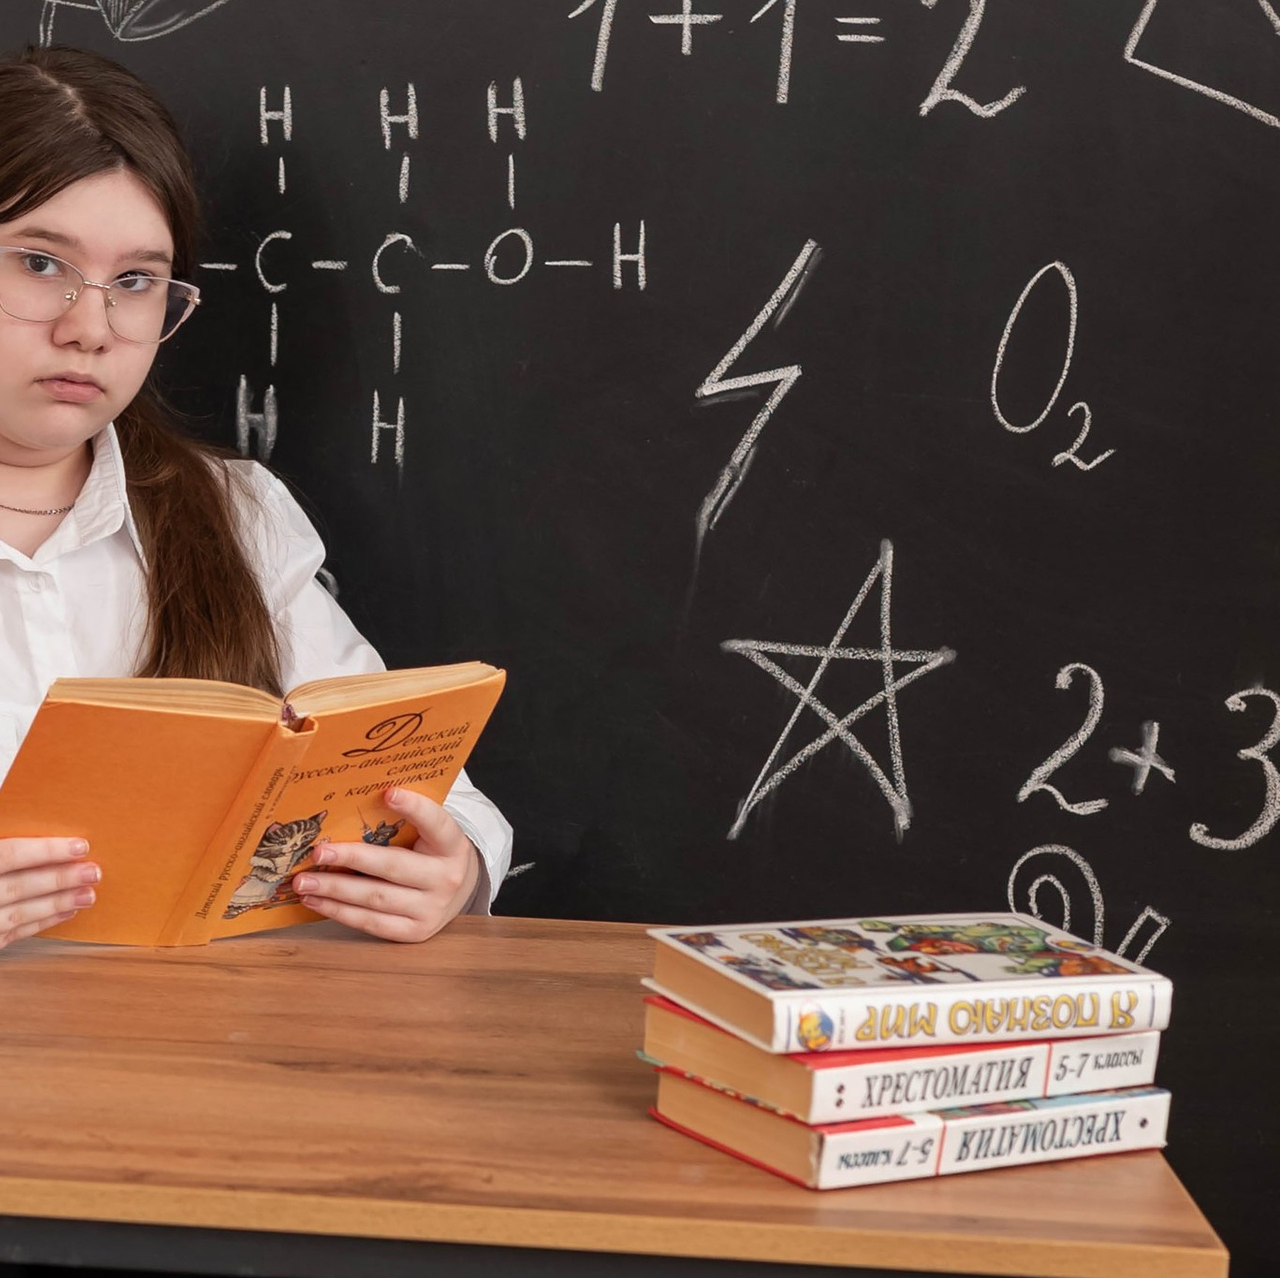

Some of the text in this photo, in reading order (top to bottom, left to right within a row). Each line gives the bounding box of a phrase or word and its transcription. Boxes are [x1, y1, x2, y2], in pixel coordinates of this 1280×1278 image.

[259, 77, 527, 150] H H H
[371, 389, 406, 465] H
[341, 706, 470, 759] Детский
[344, 766, 450, 799] картинках
[386, 754, 455, 777] словарь
[855, 1002, 938, 1041] МИР
[948, 992, 1101, 1036] ПОЗНАЮ
[1106, 990, 1139, 1031] Я
[861, 1048, 1145, 1109] ХРЕСТОМАТИЯ 5-7 классы
[838, 1110, 1127, 1171] ХРЕСТОМАТИЯ 5-7 классы
